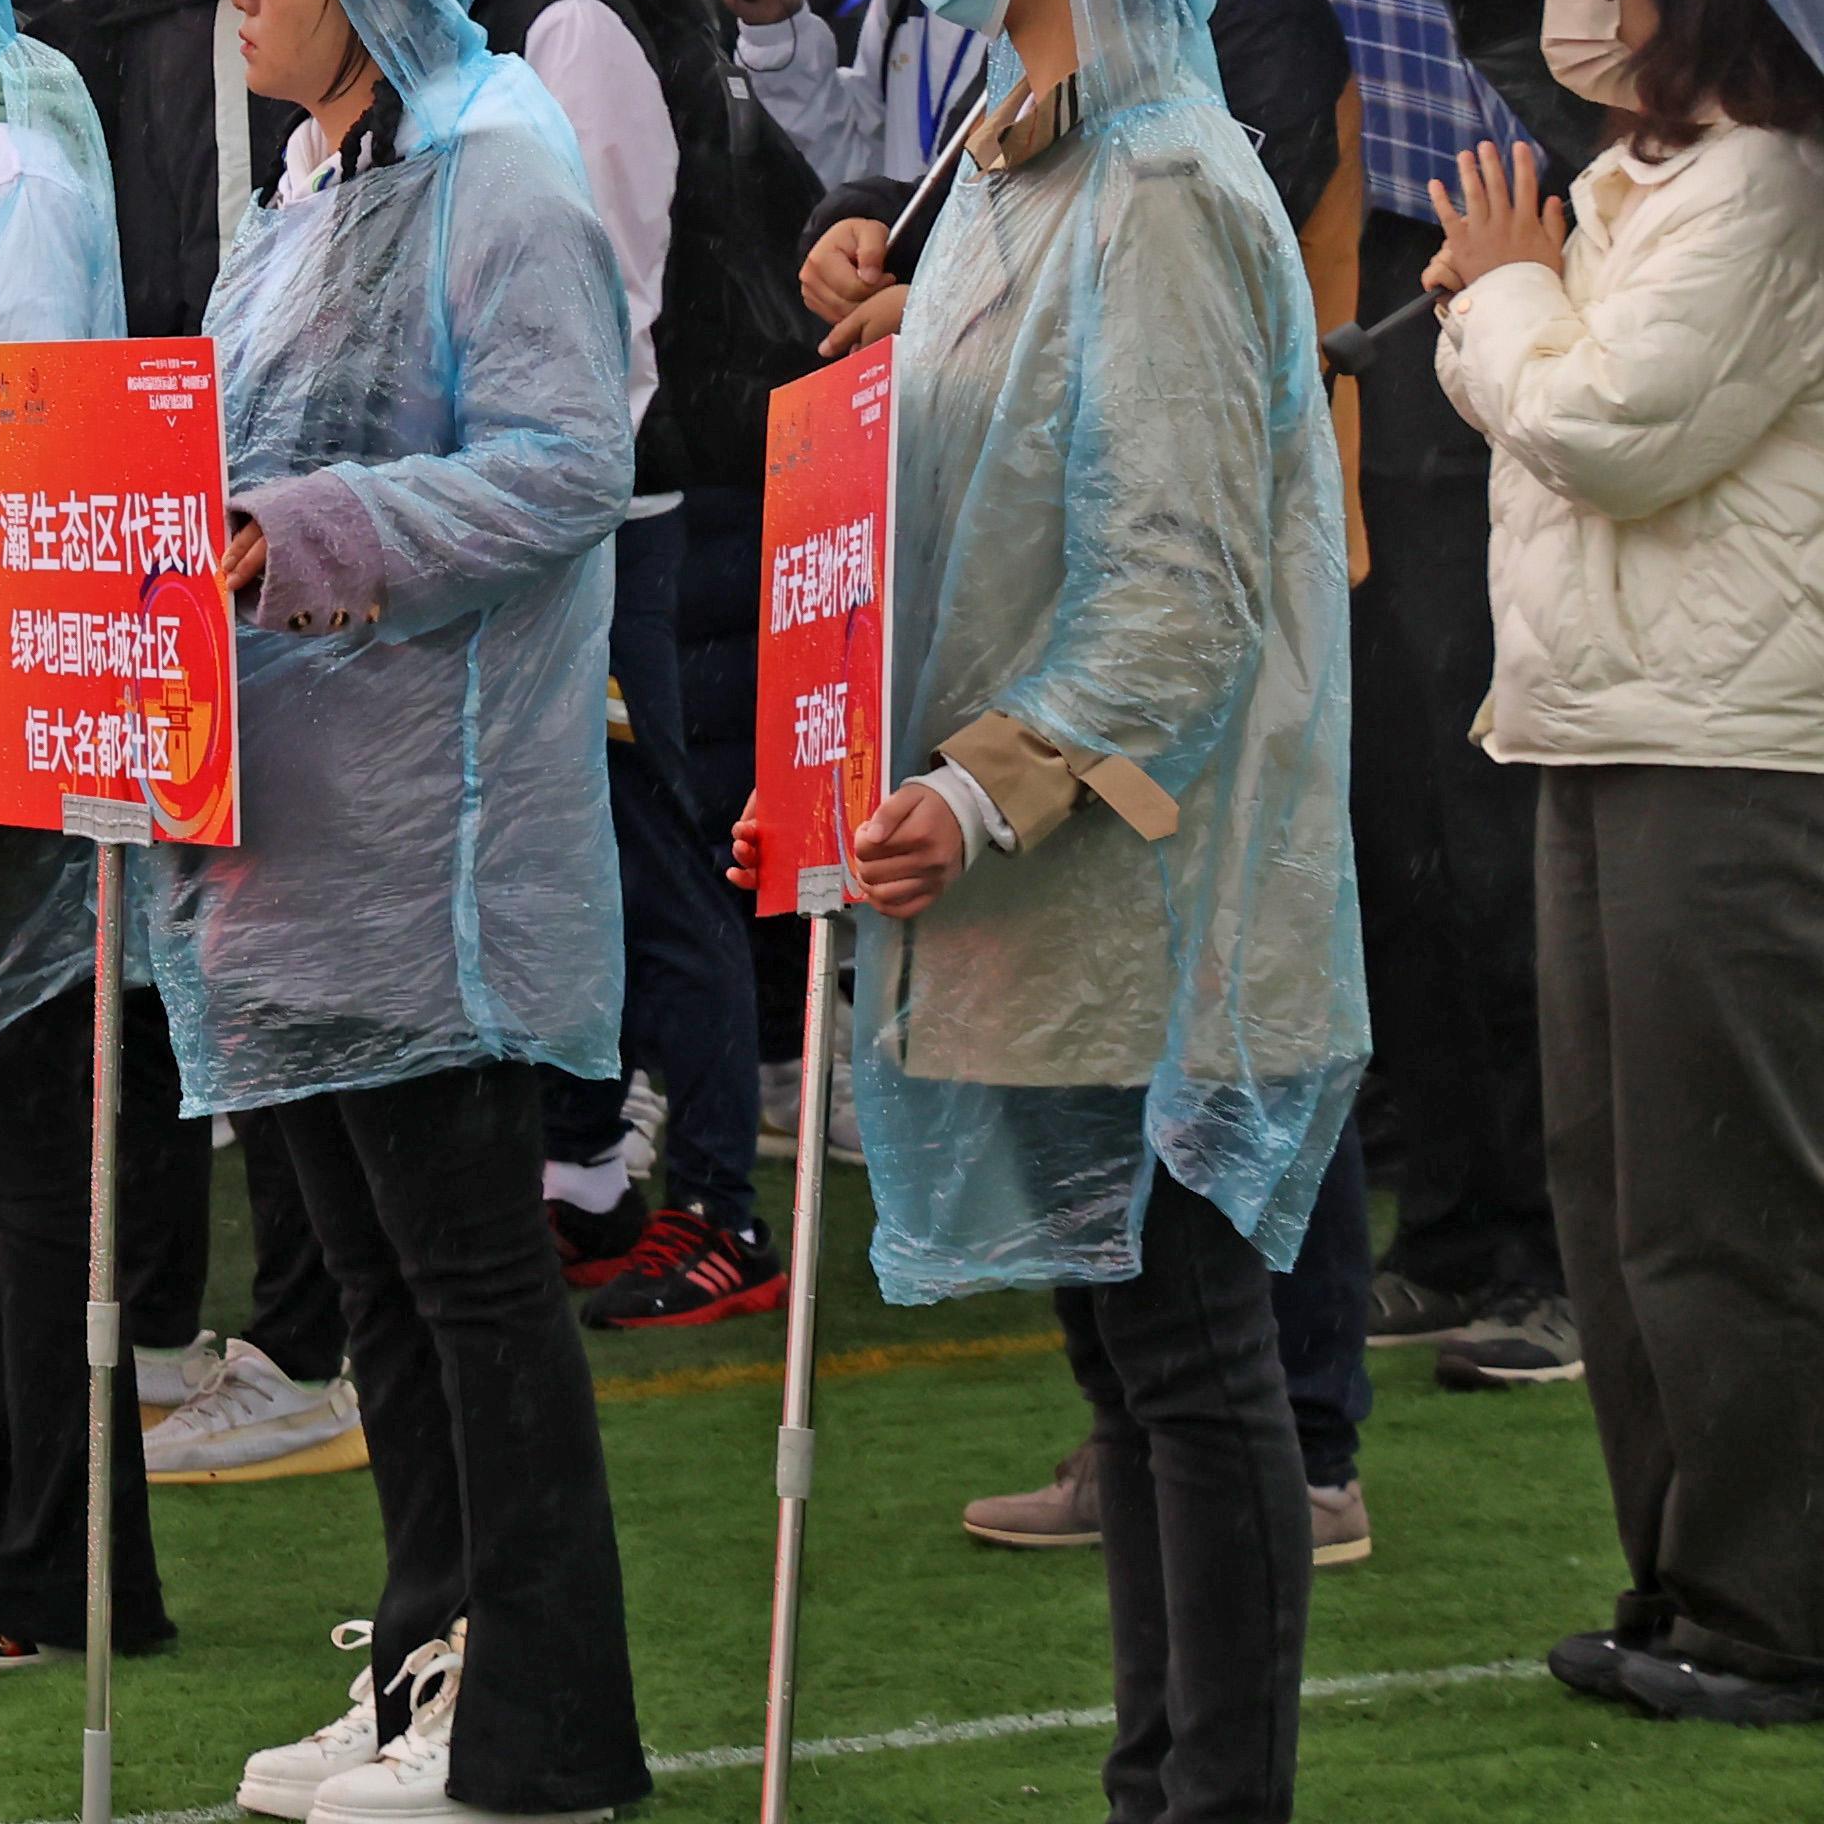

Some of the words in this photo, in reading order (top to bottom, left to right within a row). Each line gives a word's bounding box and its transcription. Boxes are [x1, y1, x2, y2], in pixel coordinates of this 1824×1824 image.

[770, 512, 875, 634] 航天基地代表队
[10, 608, 183, 680] 绿地国际城社区
[25, 706, 173, 785] 恒大名都社区
[793, 682, 848, 769] 天府社区
